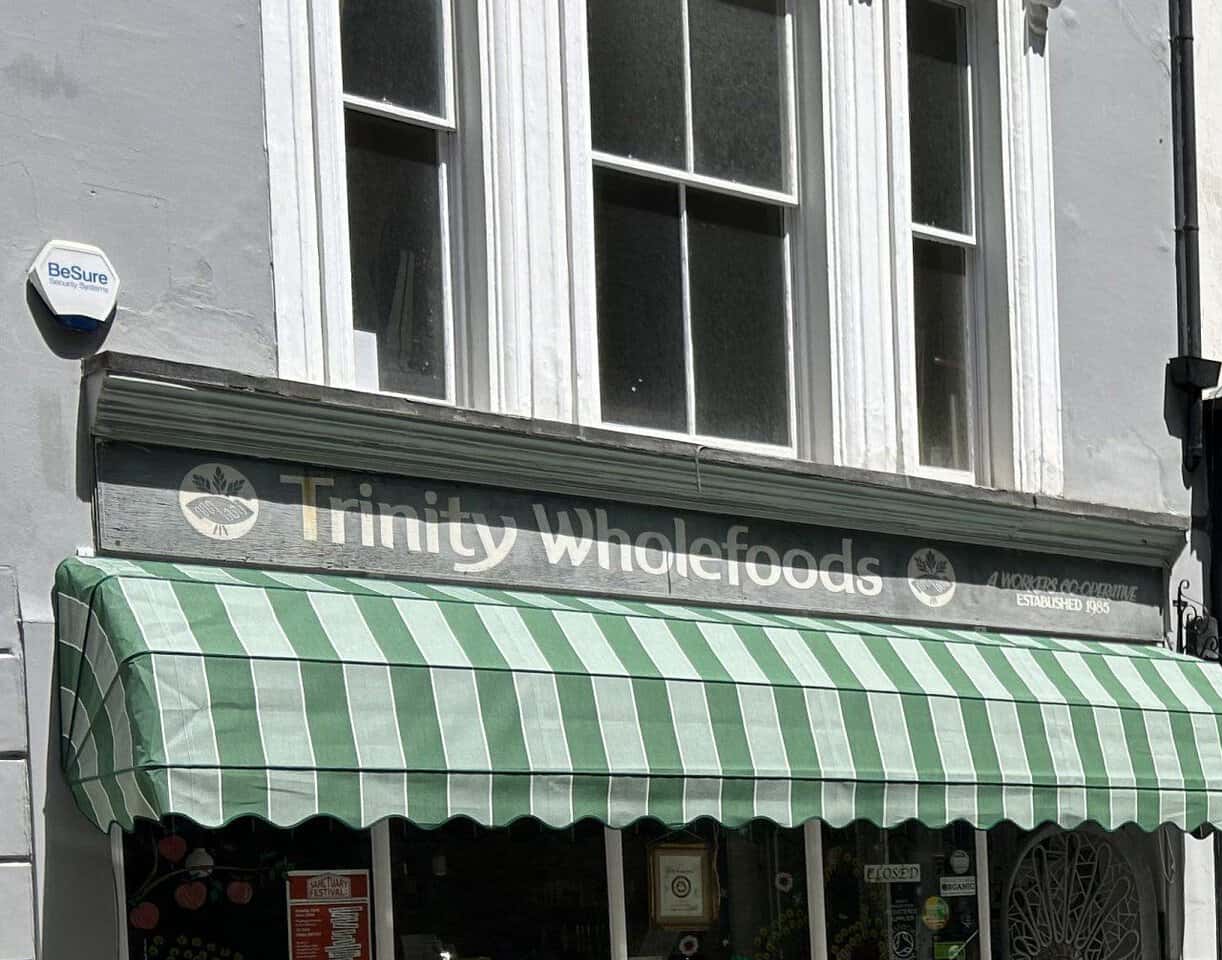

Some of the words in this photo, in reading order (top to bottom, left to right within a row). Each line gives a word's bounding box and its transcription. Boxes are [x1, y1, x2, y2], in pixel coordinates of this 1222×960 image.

[48, 262, 108, 285] BeSure
[279, 474, 517, 573] Trinity
[532, 503, 884, 597] Wholefoods
[1016, 593, 1083, 612] ESTABLISHED
[1085, 599, 1111, 616] 1985
[866, 867, 919, 880] CLOSED
